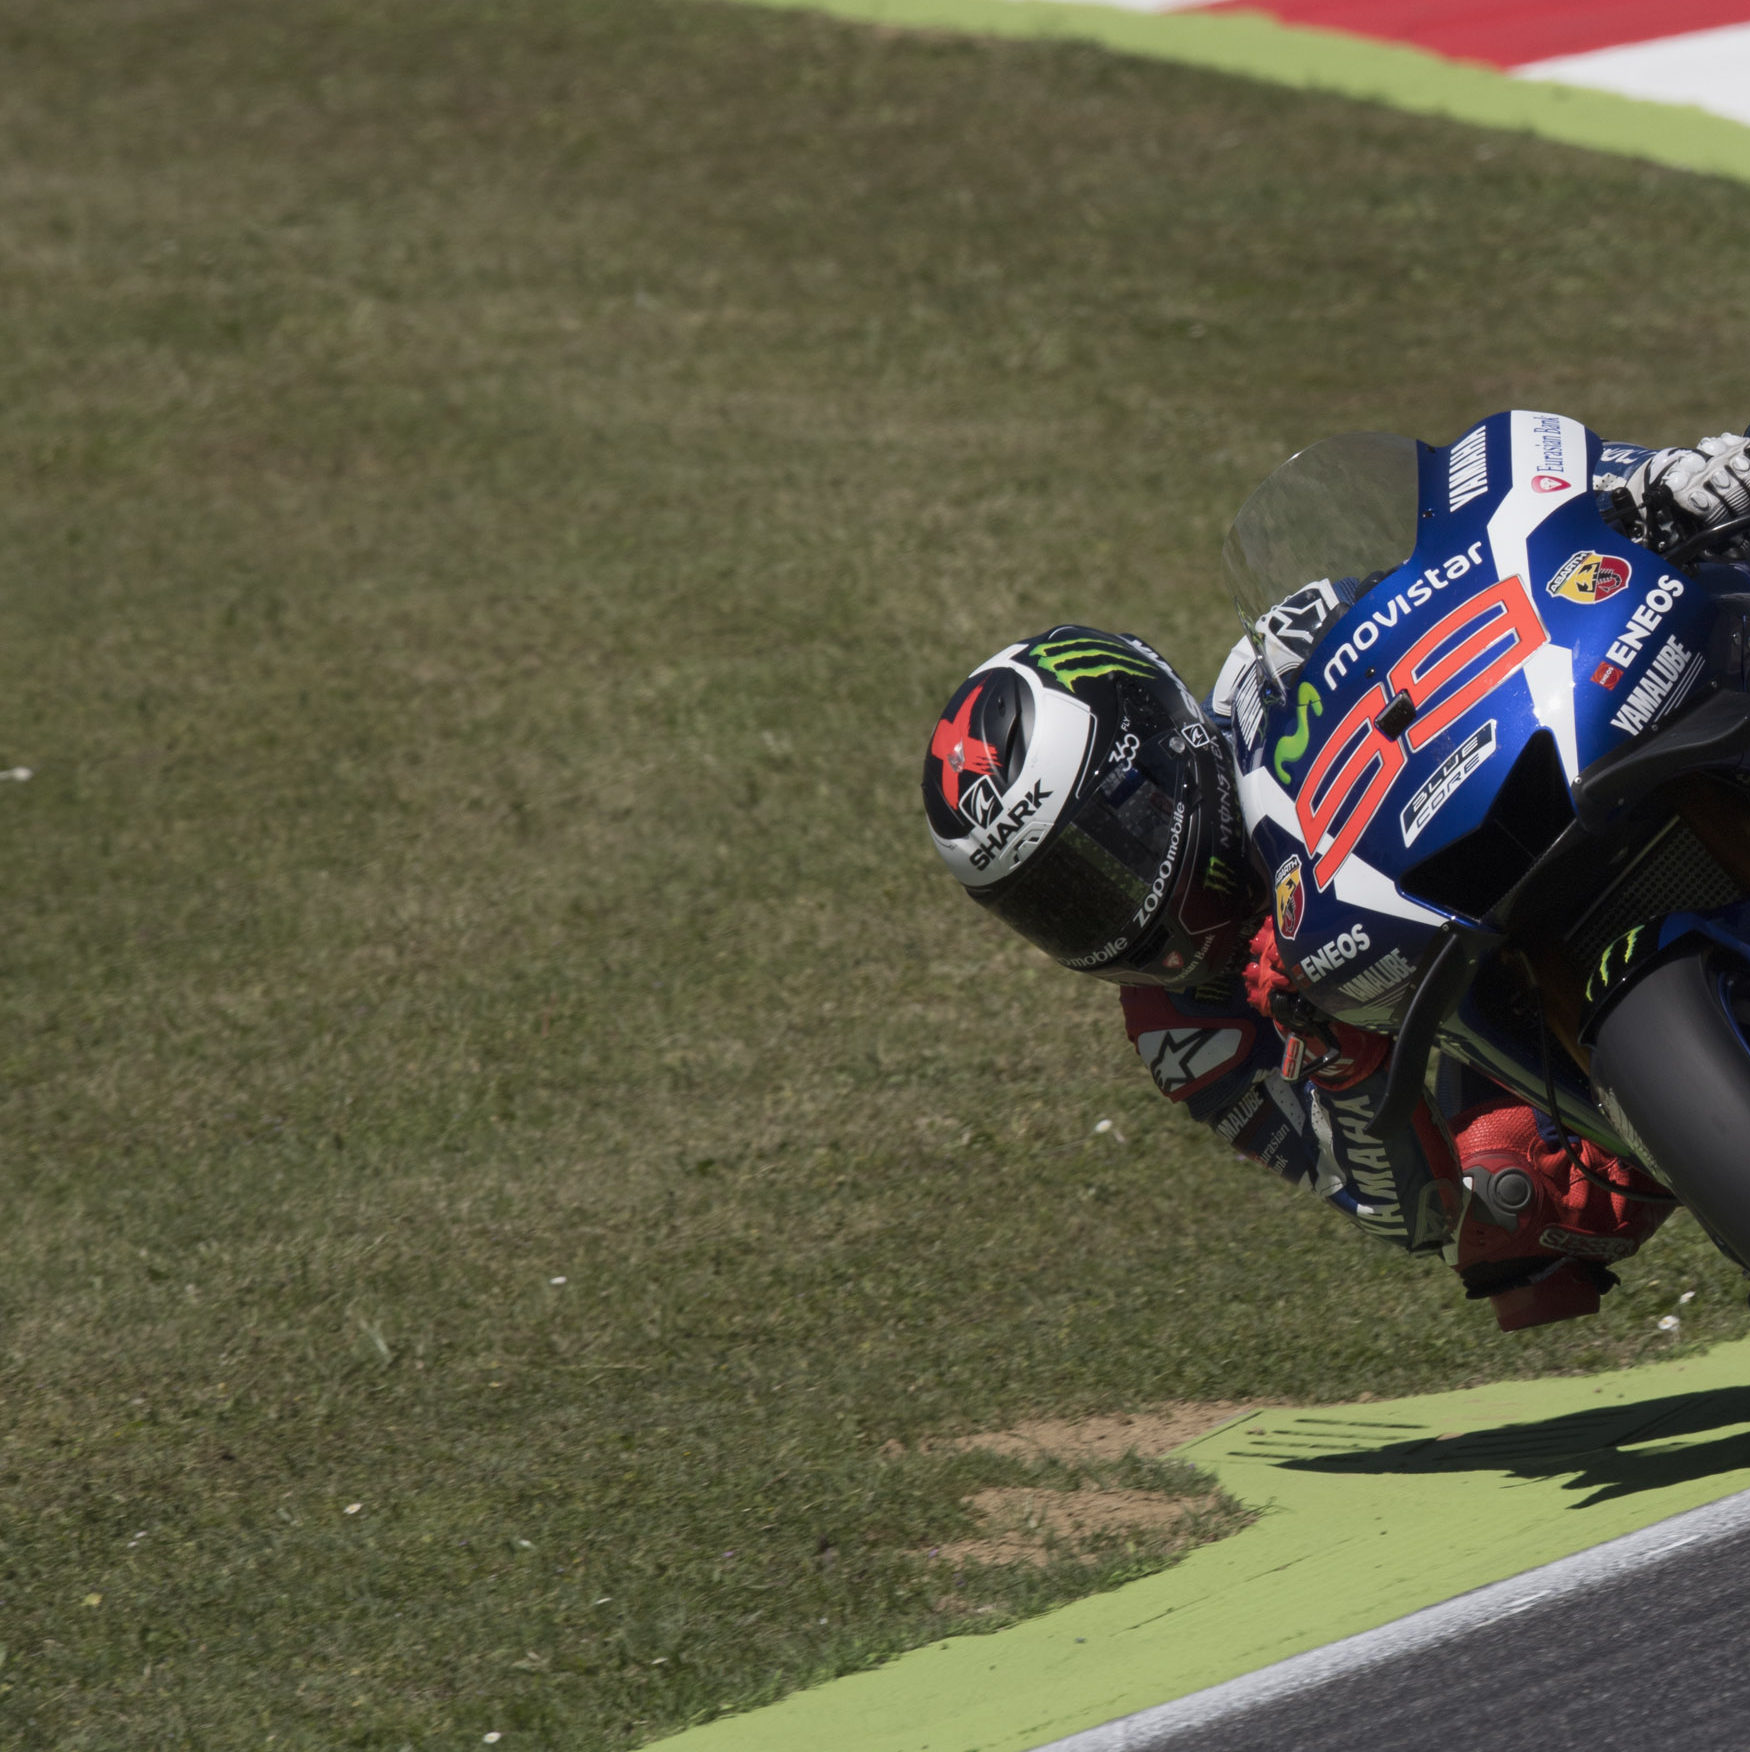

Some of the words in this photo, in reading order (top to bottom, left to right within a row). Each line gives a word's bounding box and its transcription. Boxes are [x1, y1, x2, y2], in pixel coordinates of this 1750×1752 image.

[1449, 425, 1488, 512] YAMAHA
[1536, 436, 1564, 472] Eurasian
[1550, 551, 1588, 594] ABARTH
[1323, 540, 1482, 691] movistar
[1605, 574, 1684, 668] ENEOS
[1599, 666, 1614, 686] ENEOS
[1610, 634, 1692, 737] YAMALUBE
[1411, 737, 1480, 813] BLUE
[1414, 752, 1480, 829] CORE
[969, 779, 1054, 871] SHARK
[1300, 923, 1371, 983] ENEOS
[1338, 948, 1417, 1002] YAMALUBE
[1215, 1089, 1264, 1144] MALUBE
[1257, 1123, 1291, 1163] urasian
